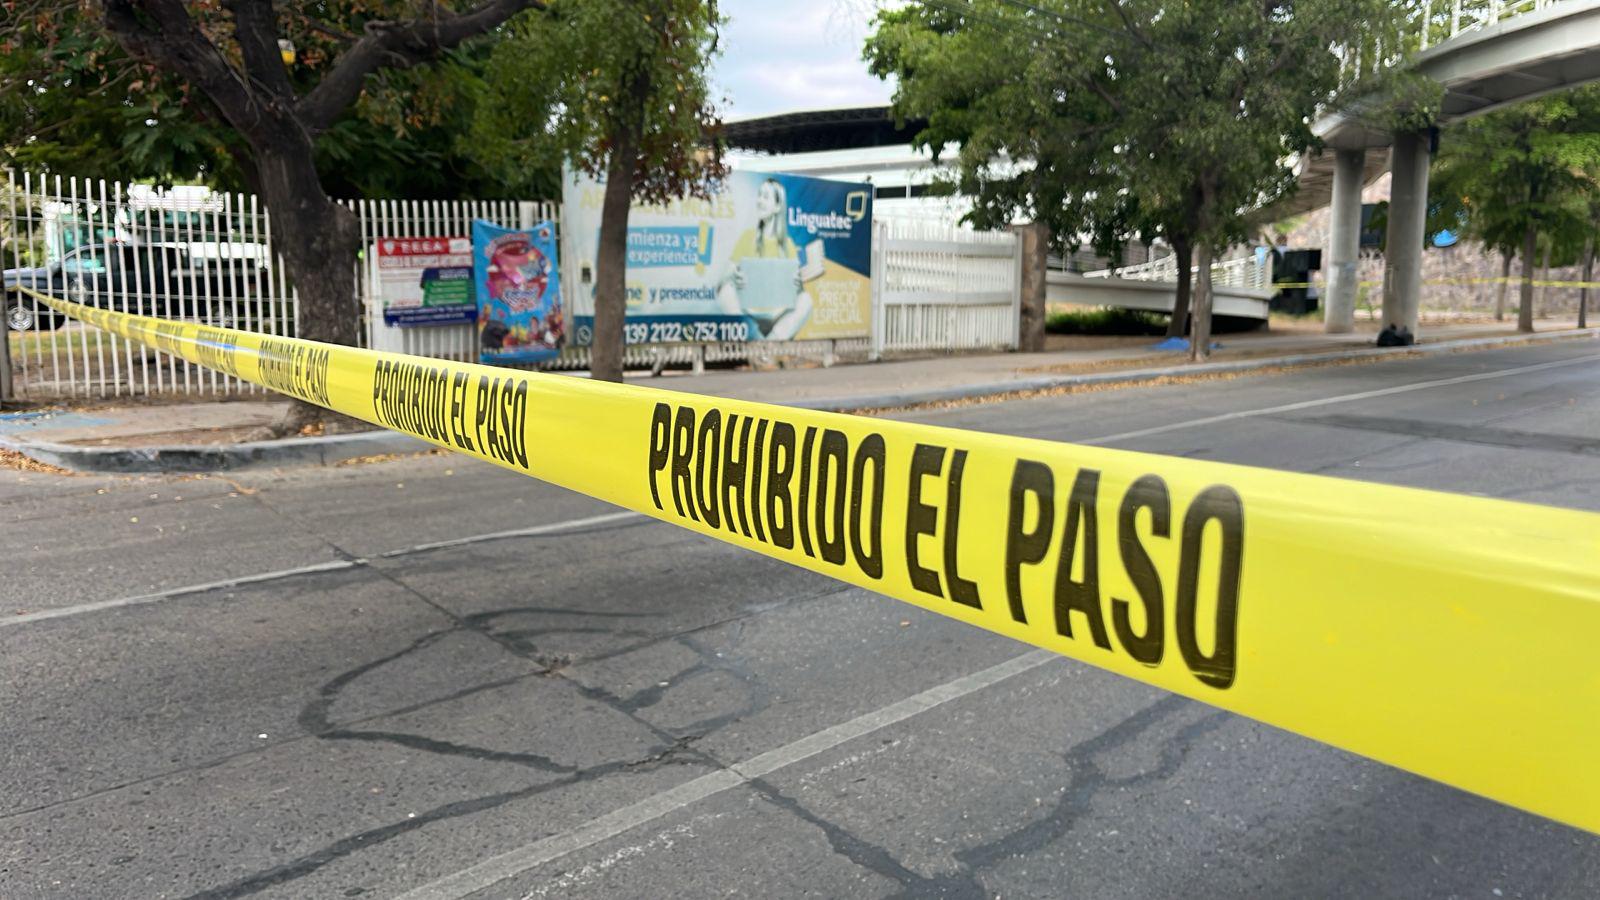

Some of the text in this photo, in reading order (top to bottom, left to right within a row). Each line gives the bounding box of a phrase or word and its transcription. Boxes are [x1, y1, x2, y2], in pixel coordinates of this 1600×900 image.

[788, 207, 852, 234] Linguatec
[629, 229, 699, 250] mienza ya
[628, 248, 698, 264] experiencia
[650, 287, 657, 302] y
[660, 285, 716, 301] presencial
[651, 322, 682, 342] 2122
[694, 322, 718, 341] 752
[719, 322, 749, 341] 1100
[306, 348, 331, 406] PASO
[373, 360, 529, 469] PROHIBIDO EL PASO
[649, 402, 1245, 690] PROHIBIDO EL PASO
